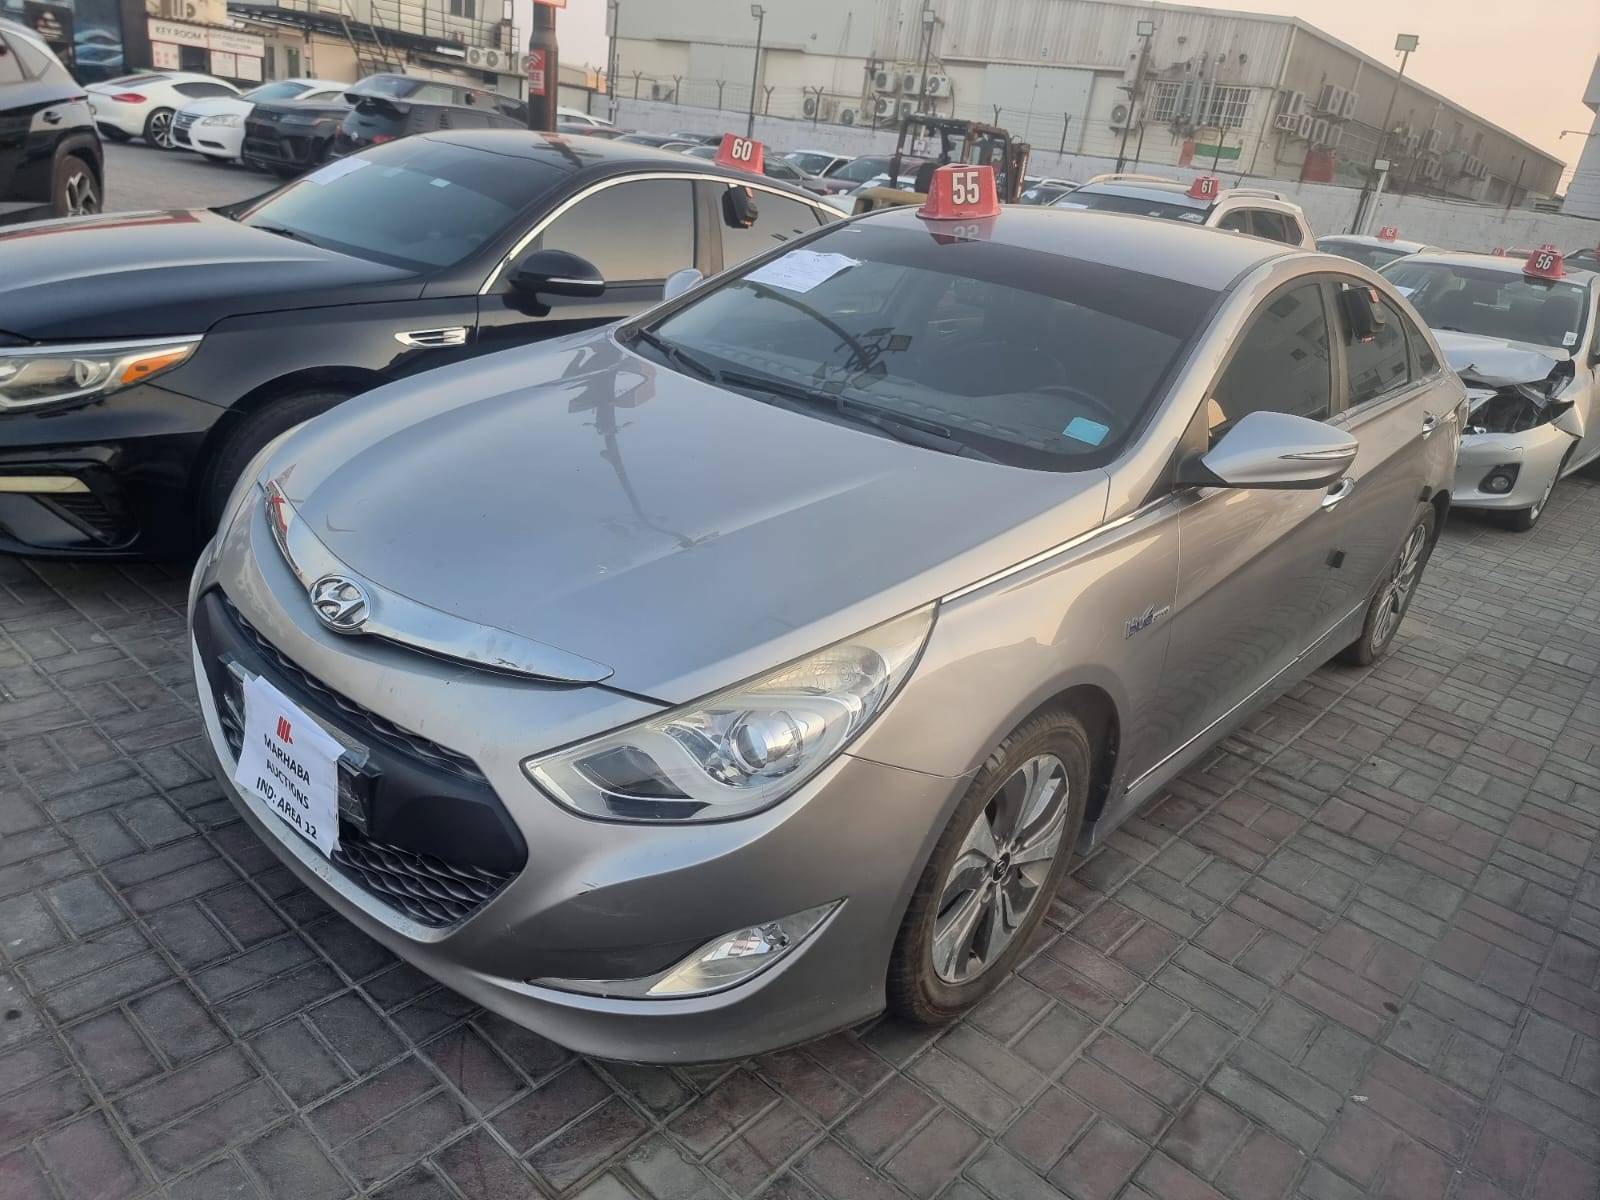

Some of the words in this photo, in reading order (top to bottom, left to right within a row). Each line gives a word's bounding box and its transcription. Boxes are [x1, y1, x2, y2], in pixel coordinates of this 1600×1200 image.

[155, 25, 172, 36] KEY
[174, 28, 201, 40] ROOM
[731, 138, 752, 161] 60
[952, 171, 979, 205] 55
[1201, 180, 1212, 193] 61
[1535, 254, 1554, 270] 56
[264, 733, 311, 786] MARHABA
[266, 759, 310, 810] AUCTIONS
[257, 776, 277, 804] IND:
[277, 797, 302, 828] AREA
[304, 821, 318, 840] 12
